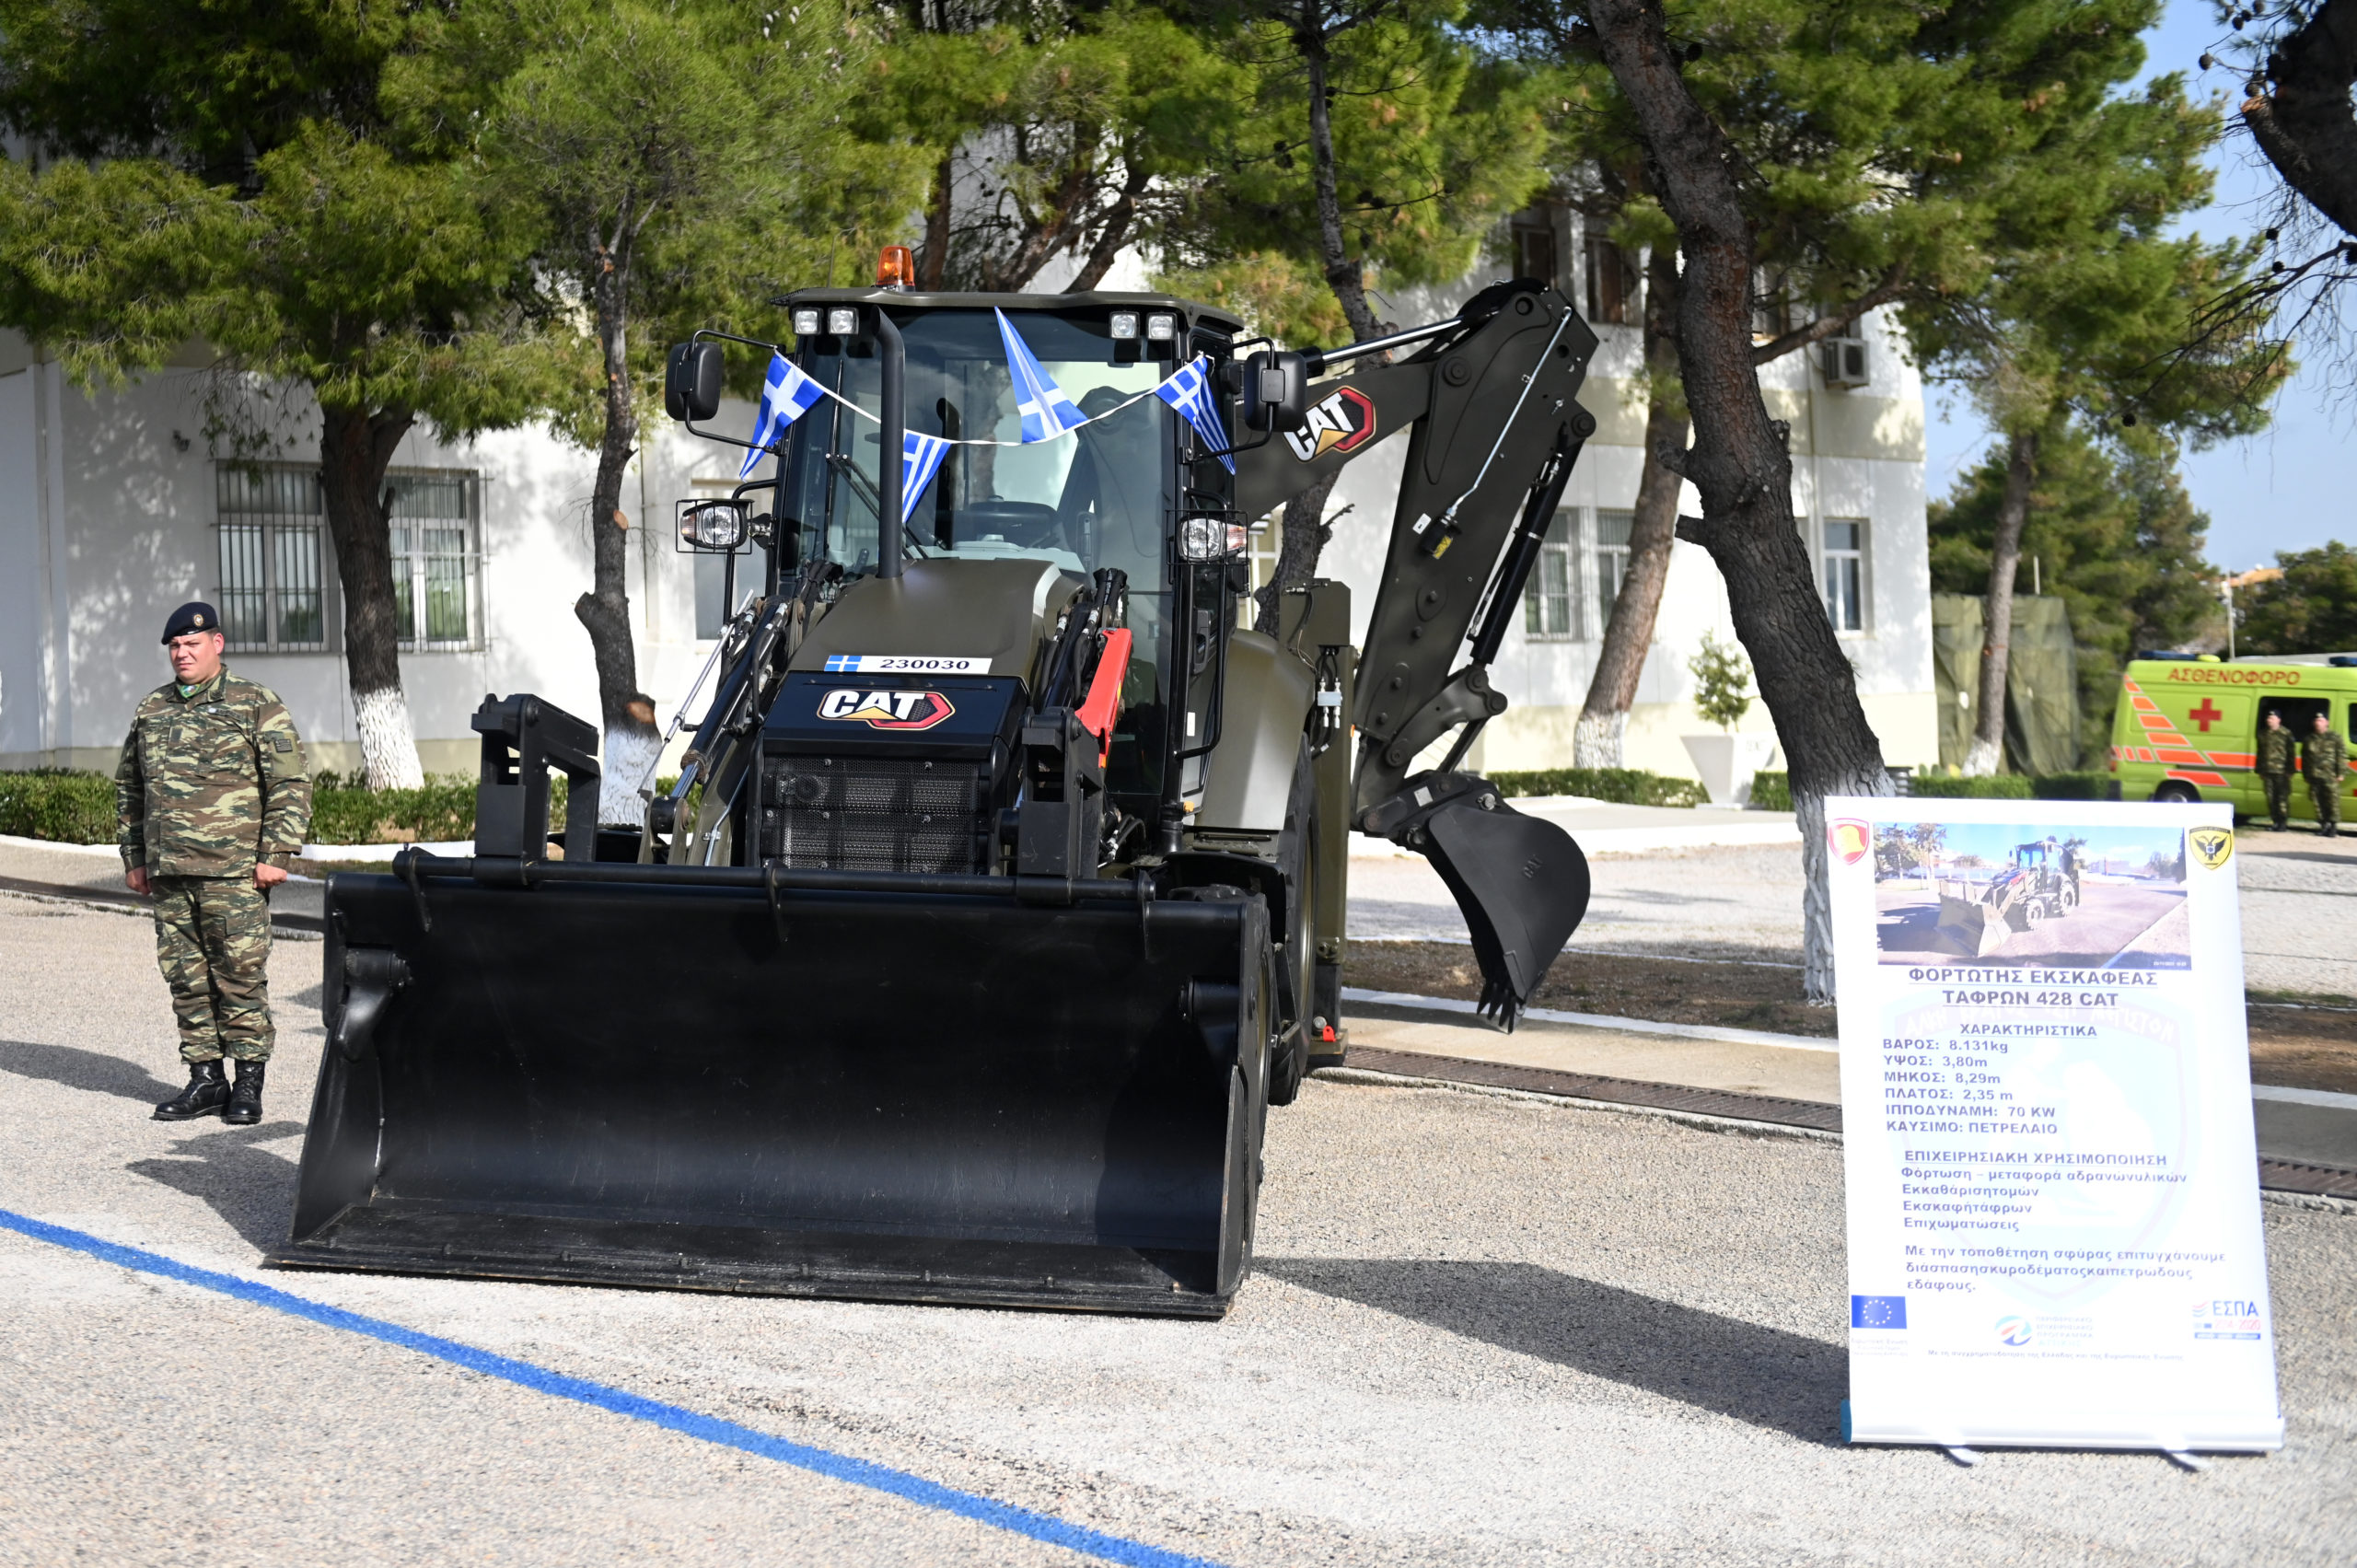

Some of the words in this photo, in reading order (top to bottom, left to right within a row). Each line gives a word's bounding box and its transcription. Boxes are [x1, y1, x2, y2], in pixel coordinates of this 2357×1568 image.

[879, 658, 970, 670] 230030
[2167, 668, 2301, 685] ΑΣΘΕΝΟΦΟΡΟ
[821, 690, 926, 721] CAT
[1909, 968, 2024, 983] ΦΟΡΤΩΤΗΣ
[2030, 970, 2158, 986] ΕΚΣΚΑΦΕΑΣ
[1942, 990, 2029, 1005] ΤΑΦΡΩΝ
[2036, 991, 2073, 1006] 428
[2079, 992, 2119, 1007] CAT
[1960, 1023, 2098, 1037] ΧΑΡΑΚΤΗΡΙΣΤΙΚΑ
[1883, 1039, 1940, 1051] ΒΑΡΟΣ:
[1948, 1040, 2009, 1054] 8.131kg
[1883, 1055, 1933, 1066] ΥΨΟΣ:
[1942, 1056, 1988, 1069] 3,80m
[1884, 1071, 1945, 1083] ΜΗΚΟΣ:
[1955, 1073, 2001, 1086] 8,29m
[1885, 1087, 1954, 1099] ΠΛΑΤΟΣ:
[1962, 1089, 1995, 1102] 2,35
[2000, 1092, 2014, 1100] m
[1886, 1104, 1998, 1117] ΙΠΠΟΔΥΝΑΜΗ:
[2007, 1106, 2026, 1117] 70
[2030, 1107, 2056, 1118] KW
[1887, 1121, 1964, 1132] ΚΑΥΣΙΜΟ:
[1968, 1122, 2059, 1134] ΠΕΤΡΕΛΑΙΟ
[1904, 1150, 2028, 1163] ΕΠΙΧΕΙΡΗΣΙΑΚΗ
[2034, 1153, 2167, 1166] ΧΡΗΣΙΜΟΠΟΙΗΣΗ
[1901, 1167, 1972, 1180] Φόρτωση
[1988, 1169, 2062, 1182] μεταφορά
[1903, 1216, 2020, 1232] Επιχωματώσεις
[1905, 1245, 1926, 1256] Με
[1931, 1248, 1955, 1259] την
[1959, 1247, 2049, 1260] τοποθέτηση
[2053, 1248, 2113, 1261] σφύρας
[2117, 1249, 2226, 1263] επιτυγχάνουμε
[1908, 1279, 1977, 1293] εδάφους.
[2212, 1300, 2259, 1317] ΕΣΠΑ
